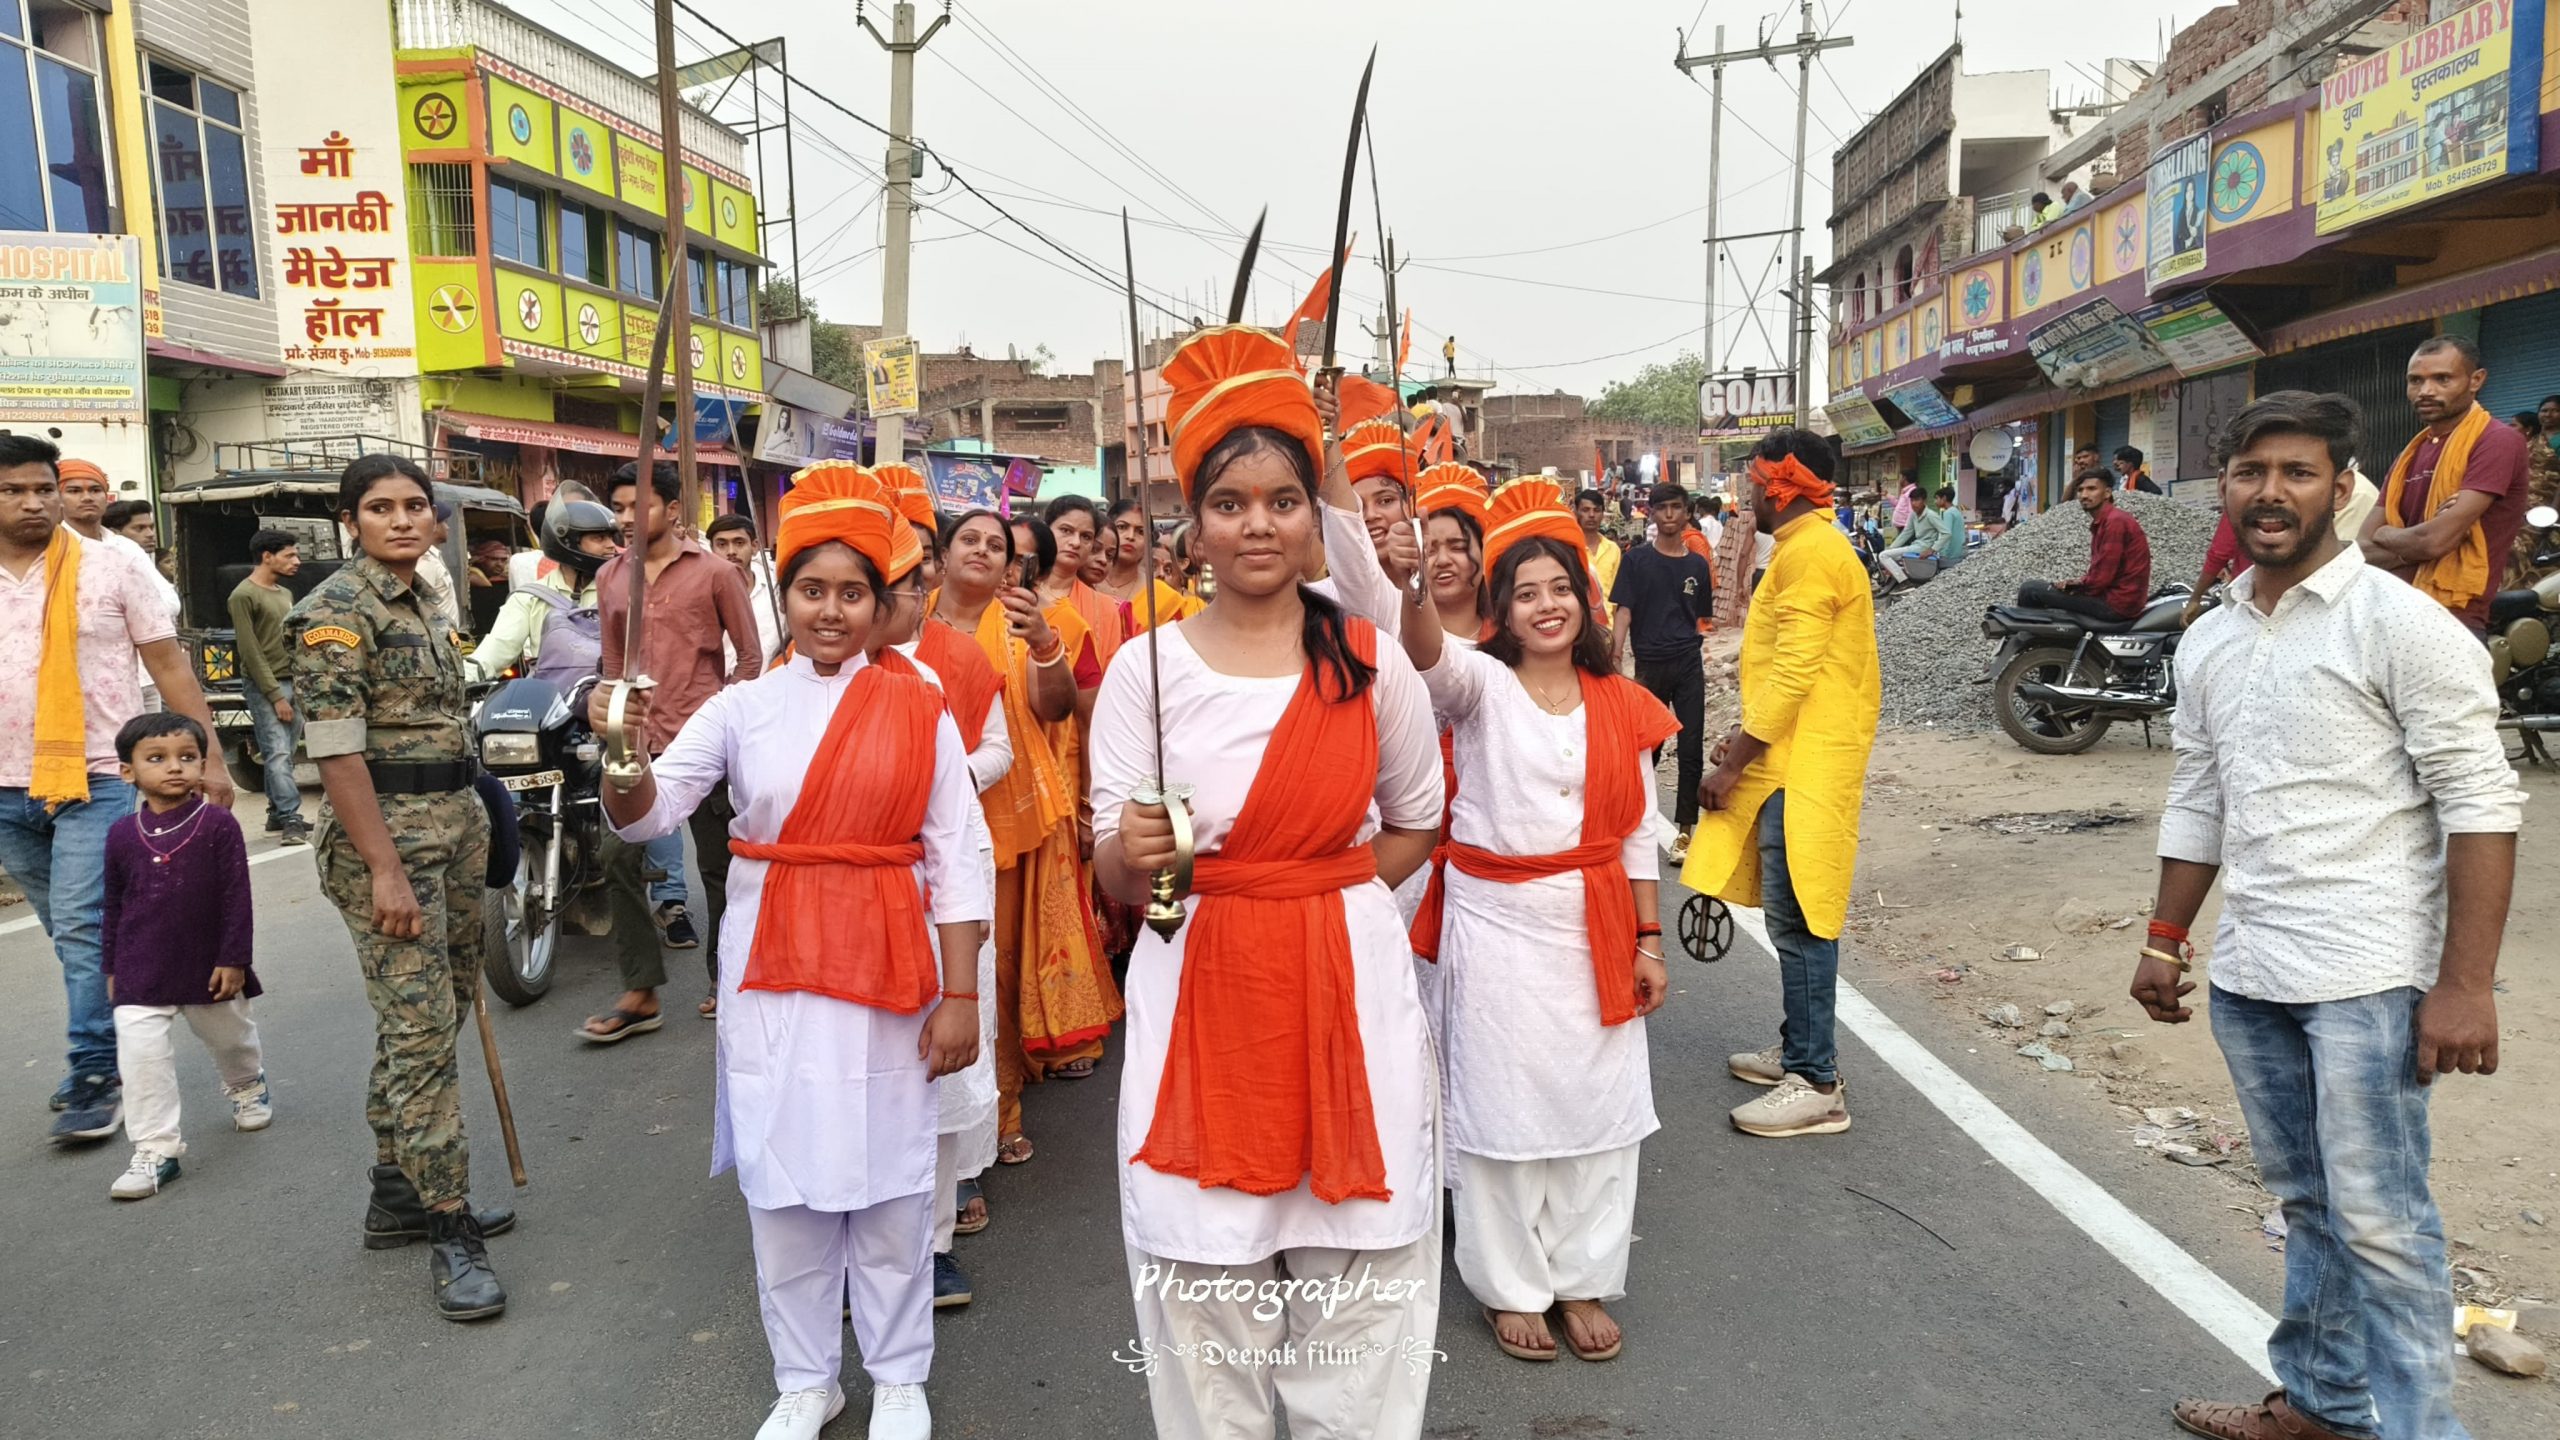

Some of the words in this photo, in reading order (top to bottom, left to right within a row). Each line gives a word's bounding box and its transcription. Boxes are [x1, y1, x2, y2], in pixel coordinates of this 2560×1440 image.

[2322, 51, 2390, 111] YOUTH
[2400, 0, 2512, 76] LIBRARY
[2342, 101, 2364, 131] युवा
[2411, 48, 2481, 101] पुस्तकालय
[298, 130, 354, 177] माँ
[2446, 158, 2498, 186] 9546956729
[275, 191, 393, 232] जानकी
[282, 247, 395, 288] मैरेज
[28, 286, 43, 299] के
[50, 286, 89, 301] अधीन
[304, 298, 384, 343] हॉल
[307, 344, 337, 361] संजय
[265, 385, 301, 397] INSTAKART
[304, 384, 336, 396] SERVICES
[337, 383, 366, 395] PRIVATE
[1701, 377, 1794, 417] GOAL
[342, 422, 365, 430] OFFICE
[830, 425, 857, 441] Goldmeda
[1738, 414, 1795, 427] INSTITUTE
[308, 629, 356, 643] COMMANDO
